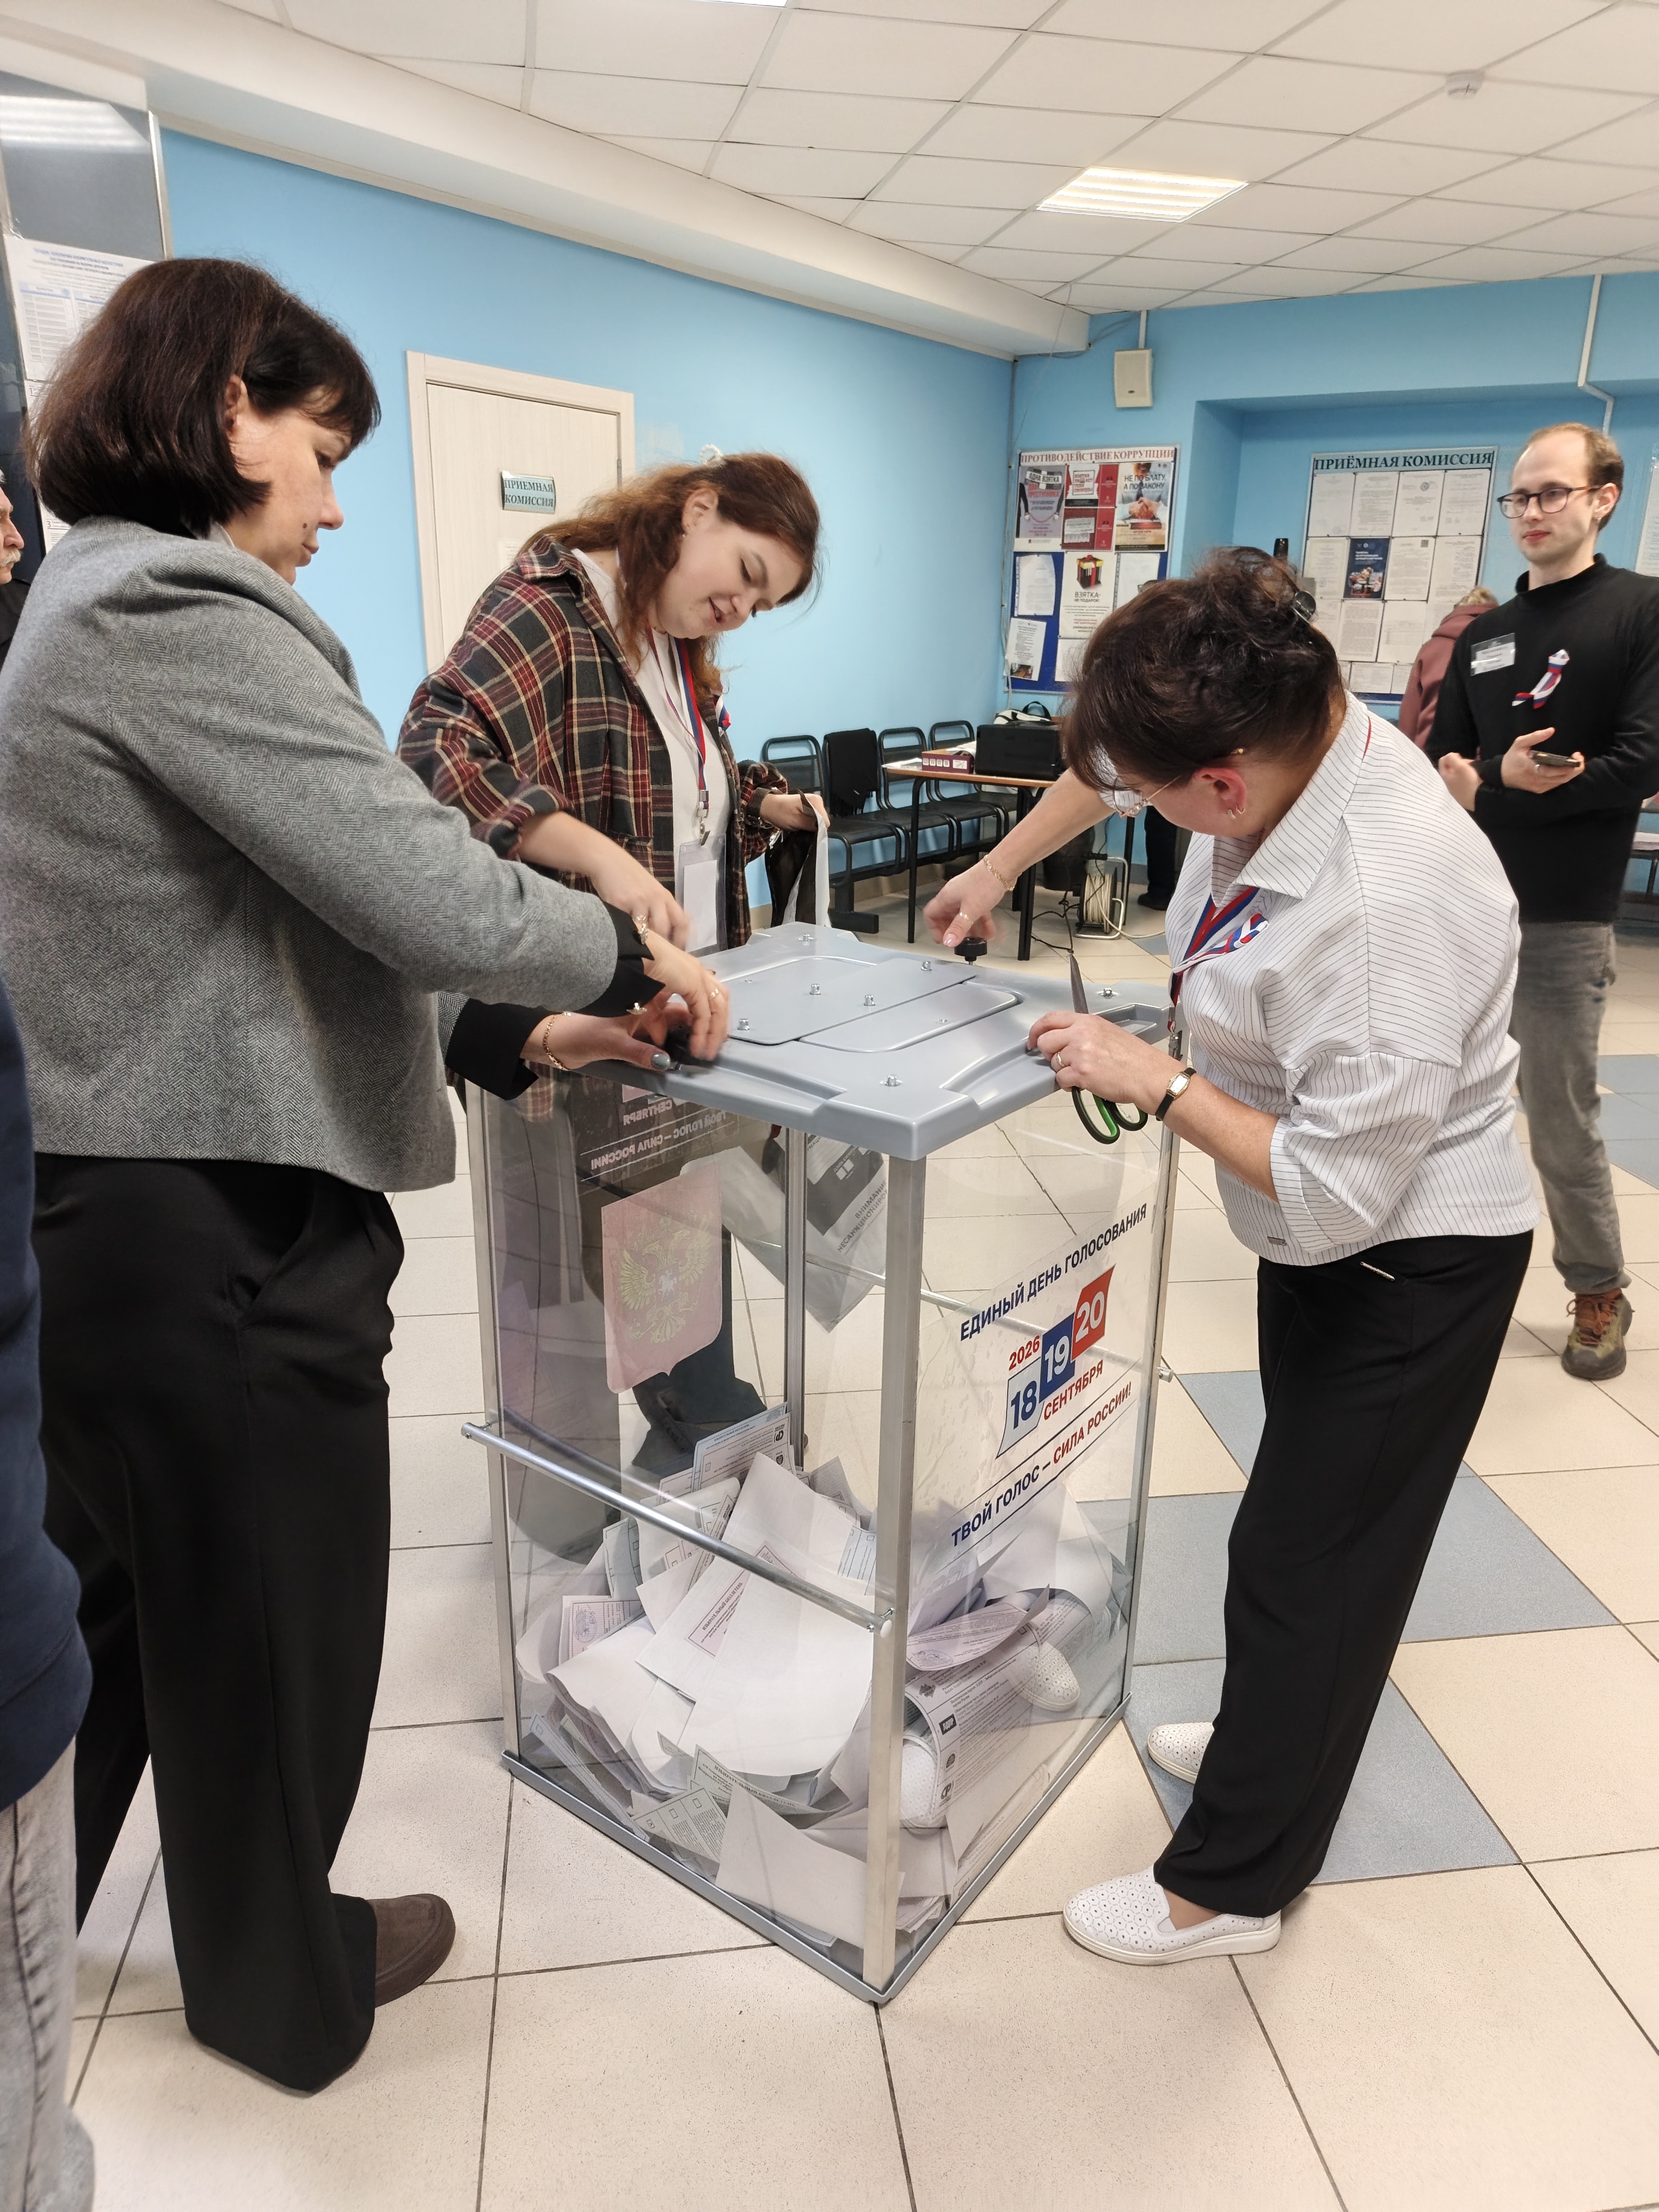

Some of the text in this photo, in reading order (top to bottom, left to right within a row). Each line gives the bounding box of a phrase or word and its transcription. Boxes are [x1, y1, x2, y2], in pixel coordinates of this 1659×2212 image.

[1021, 450, 1173, 463] ПРОТИВОДЕЙСТВИЕ КОРРУПЦИИ
[1314, 453, 1492, 470] ПРИЁМНАЯ КОМИССИЯ
[505, 480, 553, 493] ПРИЕМНАЯ
[505, 494, 553, 507] КОМИССИЯ
[837, 1189, 888, 1252] НЕСАНКЦИОНИРО
[960, 1203, 1147, 1342] ЕДИНЫЙ ДЕНЬ ГОЛОСОВАНИЯ
[1074, 1290, 1105, 1343] 20
[1009, 1335, 1040, 1371] 2026
[1044, 1335, 1070, 1383] 19
[1010, 1380, 1037, 1430] 18
[1043, 1359, 1104, 1421] СЕНТЯБРЯ
[951, 1503, 992, 1546] ТВОЙ
[996, 1465, 1040, 1515] ГОЛОС
[1053, 1430, 1085, 1465] СИЛА
[1087, 1381, 1132, 1435] РОССИИ!
